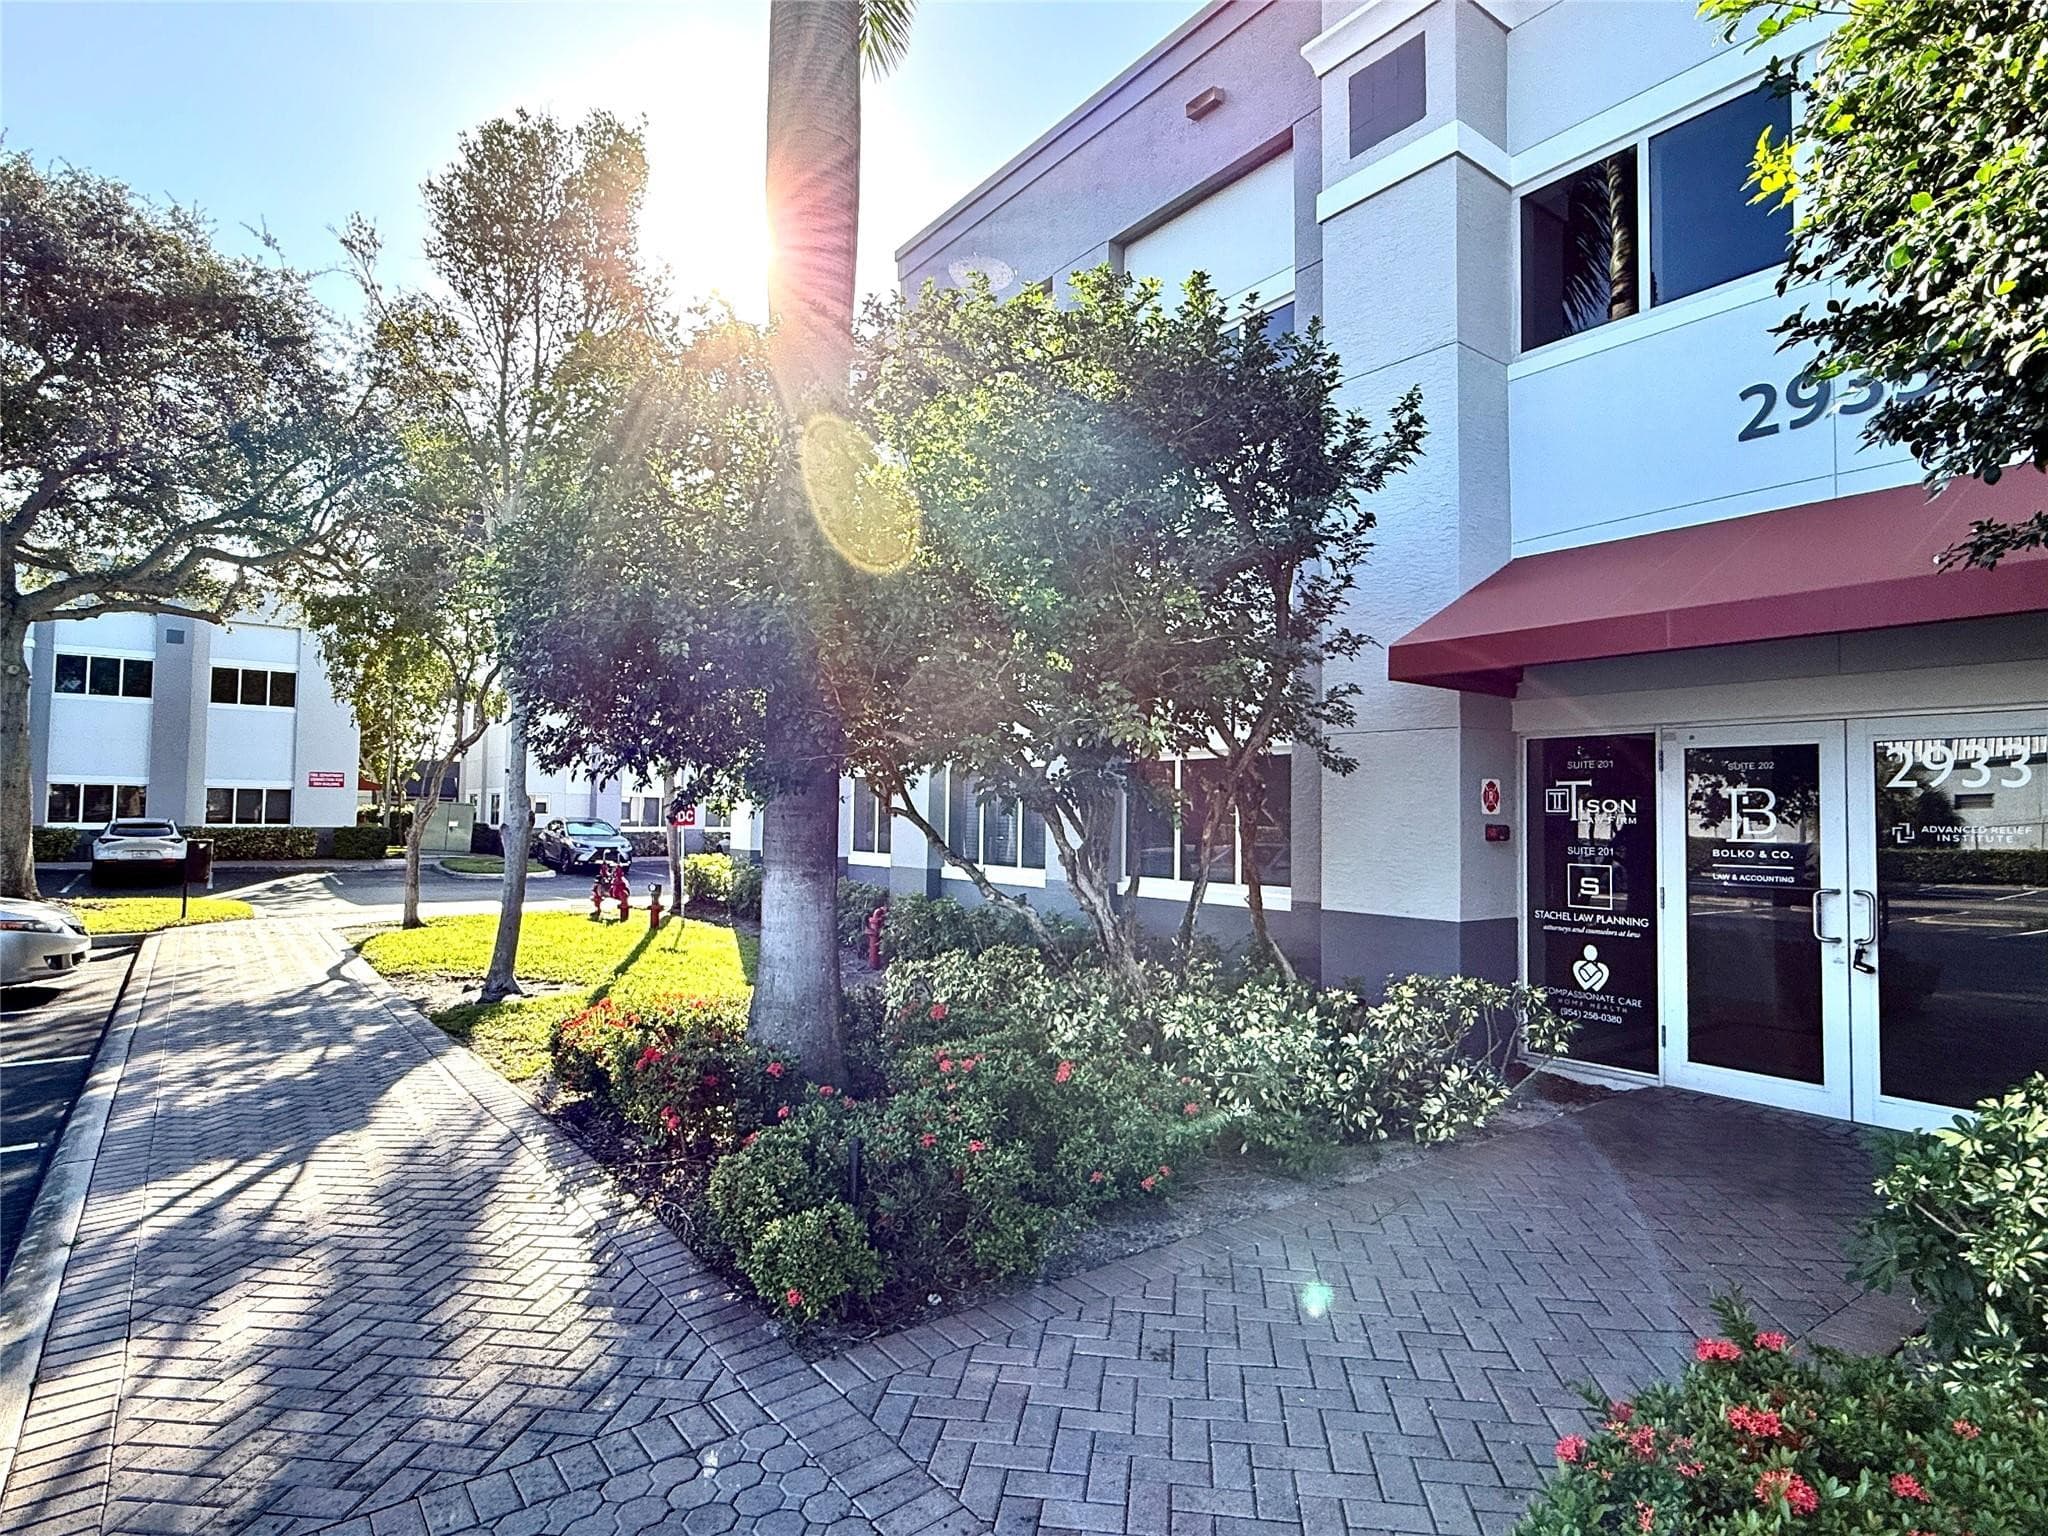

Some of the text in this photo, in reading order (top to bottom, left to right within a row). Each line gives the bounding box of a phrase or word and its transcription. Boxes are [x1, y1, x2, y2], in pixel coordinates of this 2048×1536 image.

[1567, 760, 1614, 769] SUITE 201
[1727, 761, 1775, 771] SUITE 202
[1886, 743, 2032, 788] 2933
[676, 810, 694, 822] DC
[1607, 816, 1637, 825] FIRM
[1921, 825, 2033, 835] ADVANCED RELIEF
[1936, 834, 2014, 843] INSTITUTE
[1567, 846, 1614, 856] SUITE 201
[1712, 848, 1794, 859] BOLKO & CO.
[1712, 872, 1795, 883] LAW & ACCOUNTING
[1580, 877, 1600, 895] S
[1534, 909, 1649, 928] STACHEL LAW PLANNING
[1558, 998, 1628, 1014] HOME HEALTH
[1618, 997, 1643, 1008] CARE
[1560, 1007, 1582, 1018] (954)
